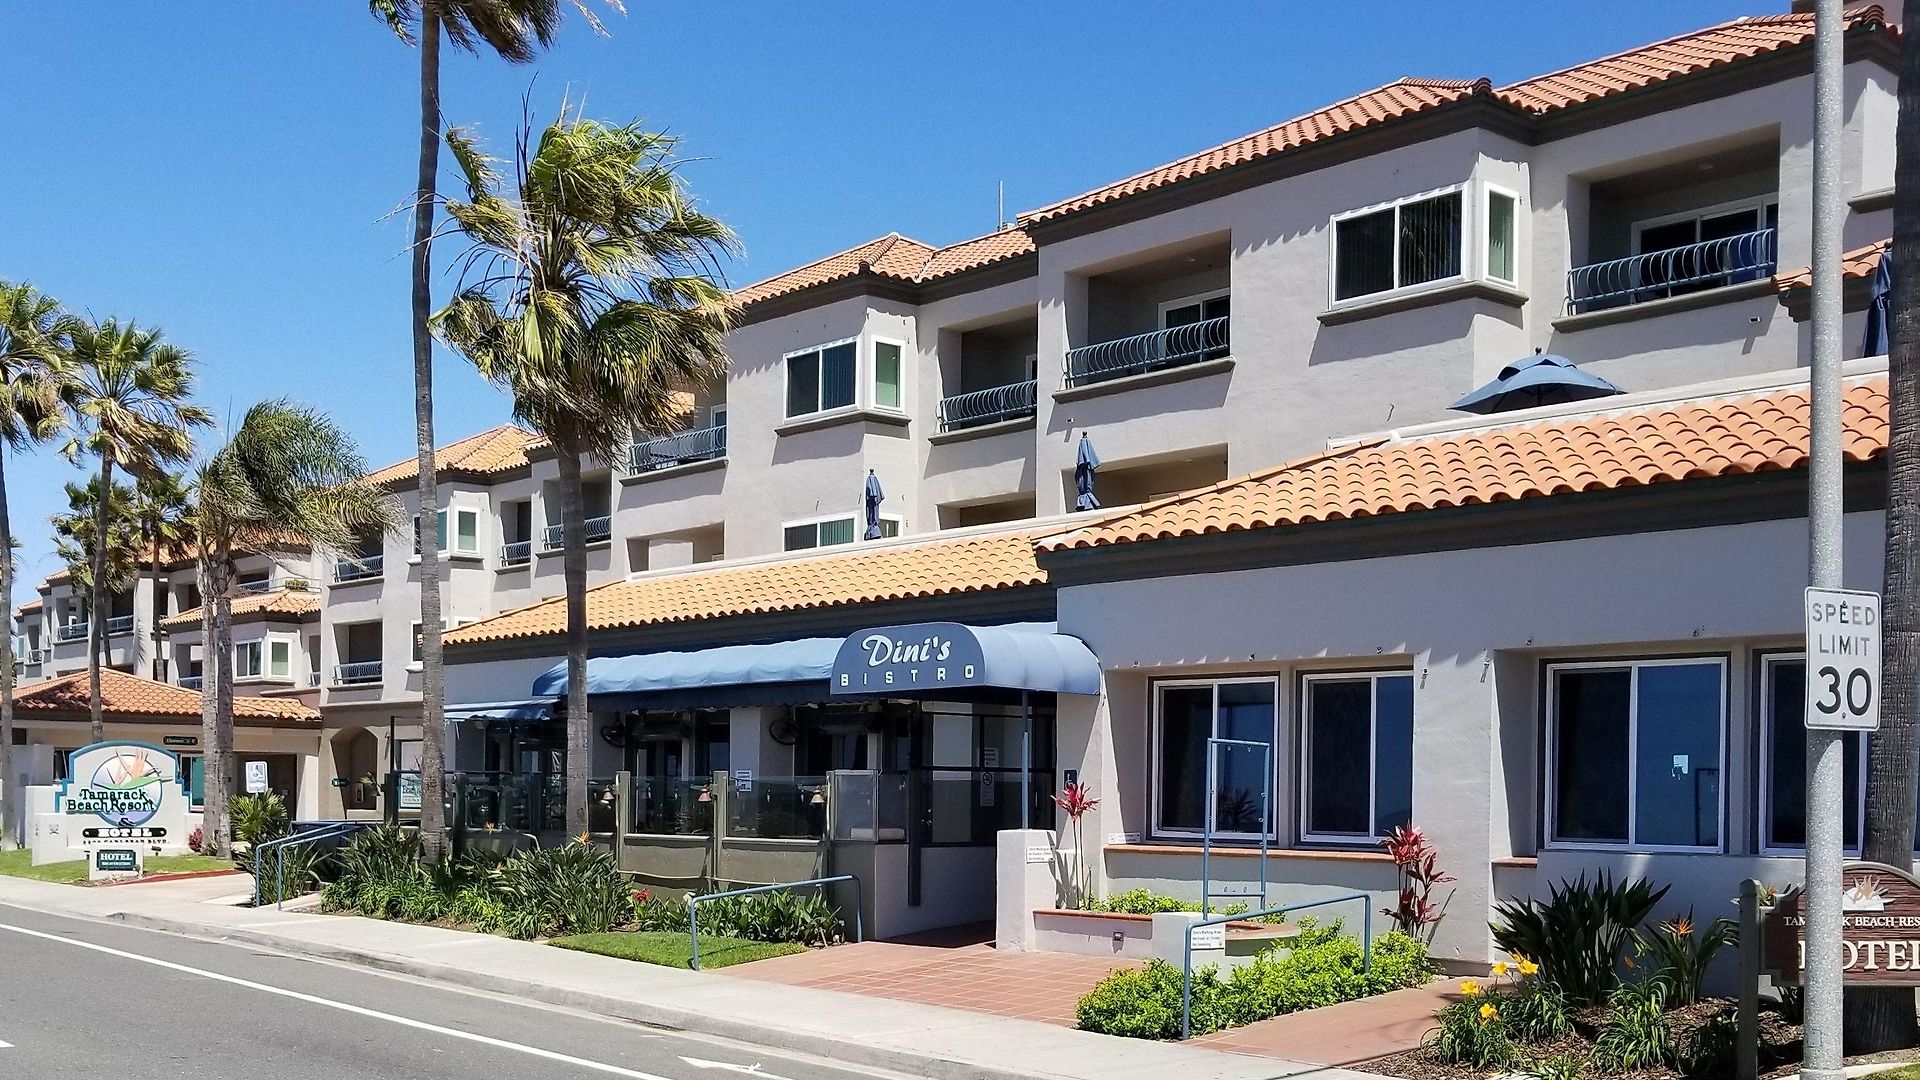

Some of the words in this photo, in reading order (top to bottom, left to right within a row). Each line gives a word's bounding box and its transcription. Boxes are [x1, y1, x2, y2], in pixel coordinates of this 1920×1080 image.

[1812, 602, 1876, 626] SPEED
[861, 634, 951, 667] Dini's
[1819, 633, 1870, 656] LIMIT
[840, 664, 975, 687] BISTRO
[1815, 665, 1872, 716] 30
[80, 788, 147, 800] Tamarack
[67, 799, 110, 812] Beach
[110, 798, 157, 815] Resort
[98, 828, 152, 837] HOTEL
[100, 853, 133, 861] HOTEL
[1855, 916, 1895, 927] BEACH
